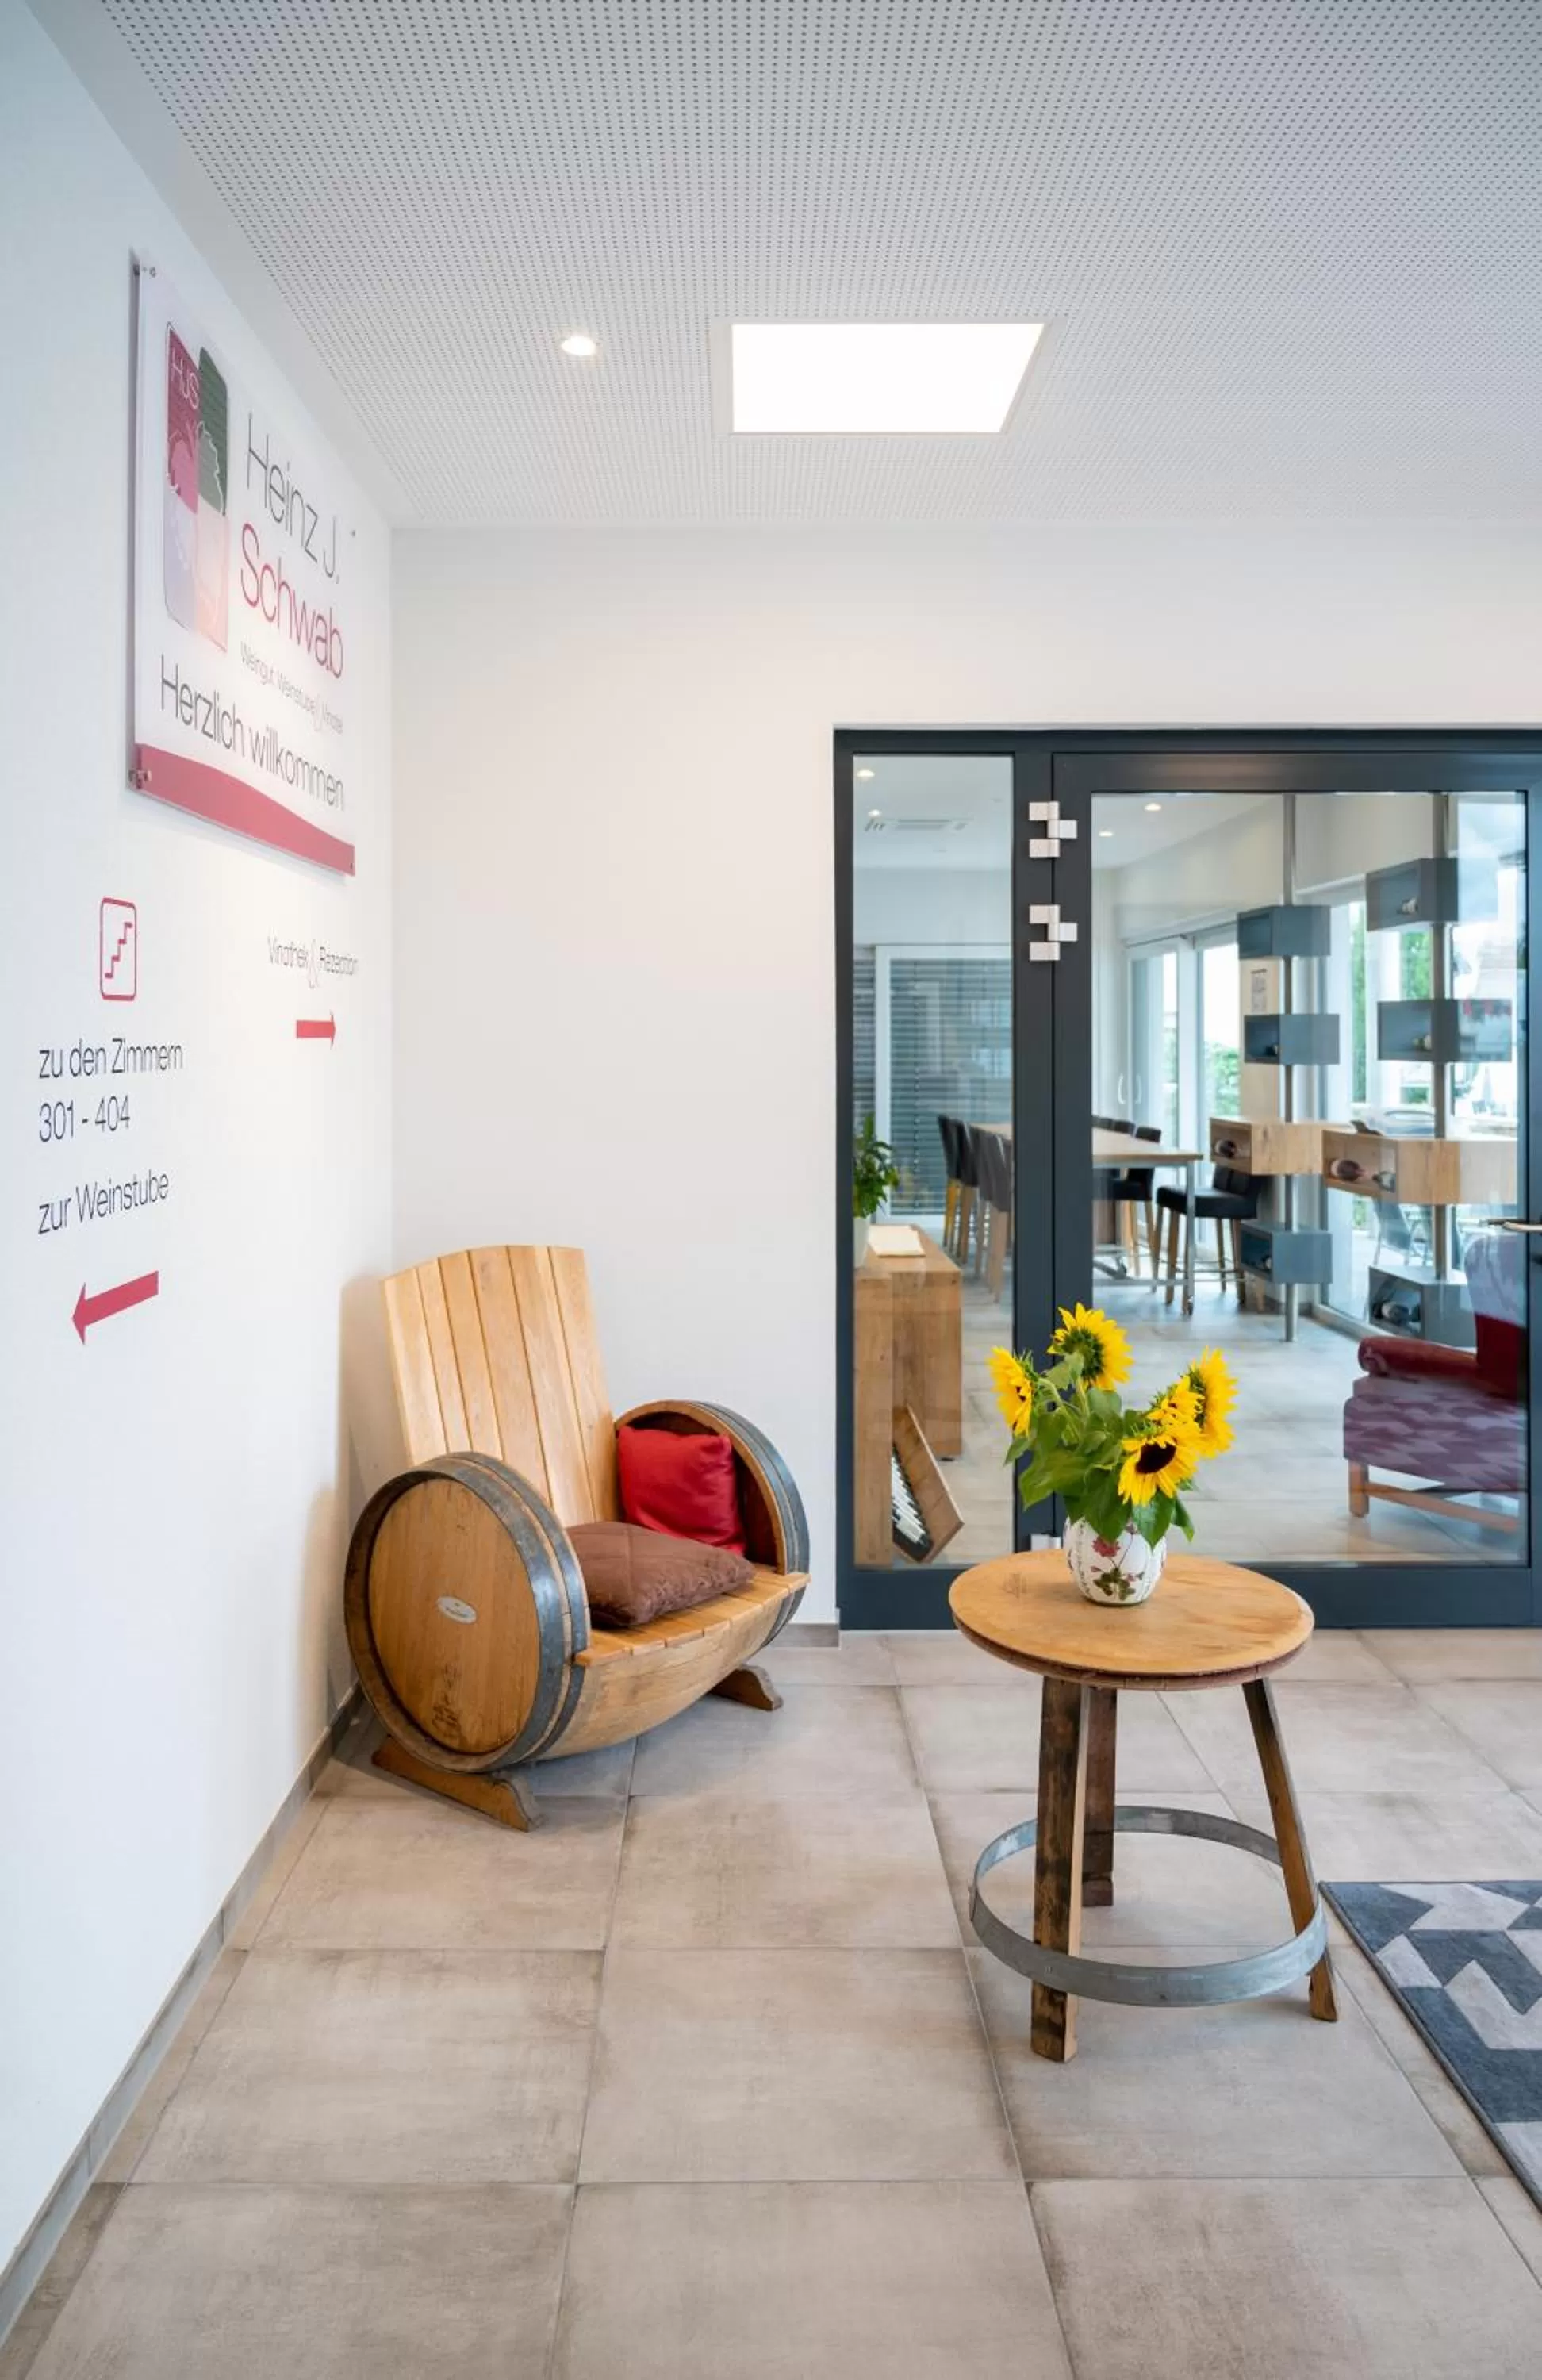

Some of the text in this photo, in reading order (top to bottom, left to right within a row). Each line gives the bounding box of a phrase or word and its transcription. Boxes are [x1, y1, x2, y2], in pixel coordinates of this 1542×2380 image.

[246, 411, 340, 585] Heinz J.
[240, 521, 343, 680] Schwab
[161, 653, 245, 758] Herzlich
[248, 724, 343, 812] willkommen
[39, 1037, 183, 1080] zu den Zimmern
[39, 1100, 75, 1143] 301
[94, 1095, 131, 1133] 404
[38, 1169, 170, 1235] zur Weinstube
